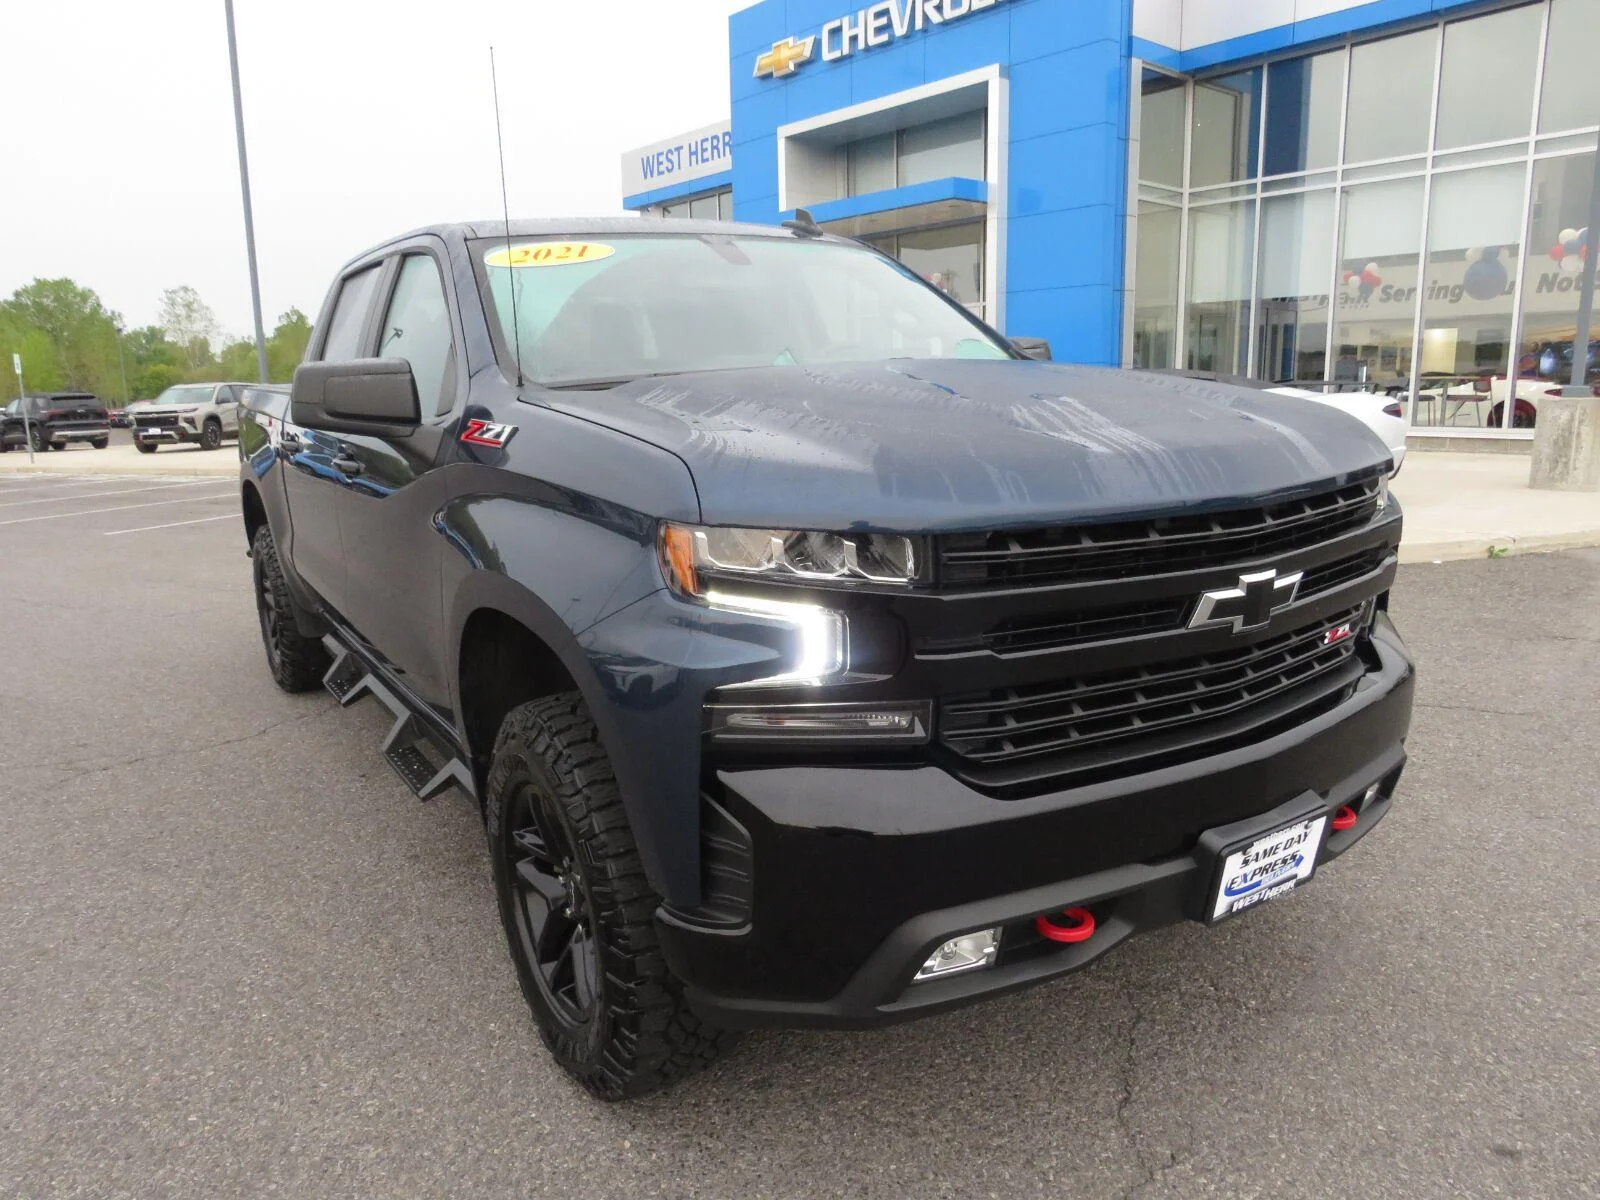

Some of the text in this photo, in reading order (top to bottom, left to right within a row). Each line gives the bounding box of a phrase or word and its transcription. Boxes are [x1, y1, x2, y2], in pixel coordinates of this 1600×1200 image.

[822, 0, 996, 62] CHEVRO
[641, 131, 732, 180] WEST HERR
[512, 245, 588, 264] 2021
[1379, 279, 1464, 304] Sering
[460, 418, 517, 448] Z71
[1240, 842, 1283, 869] SAME
[1283, 829, 1312, 851] DAY
[1229, 849, 1301, 890] EXPRESS
